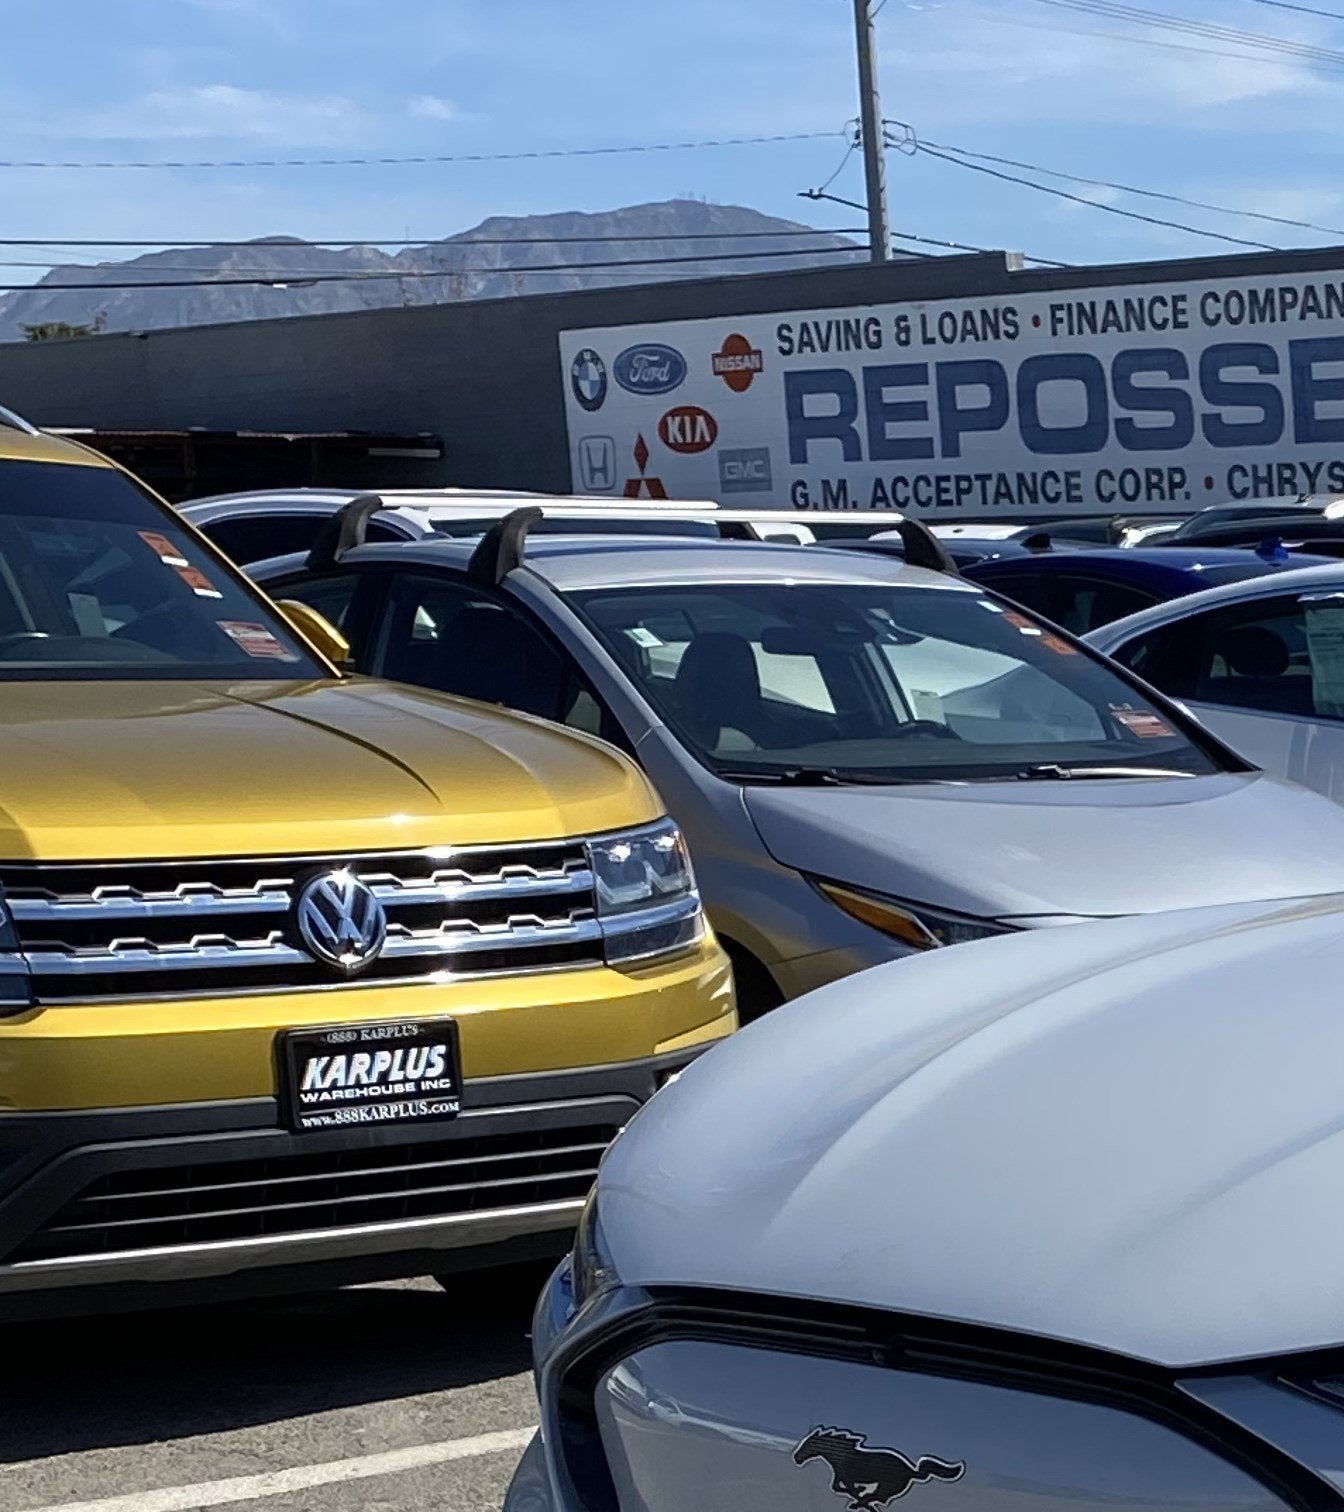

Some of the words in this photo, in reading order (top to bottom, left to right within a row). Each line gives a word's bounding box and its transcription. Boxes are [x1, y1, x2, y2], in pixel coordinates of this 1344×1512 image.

[776, 316, 883, 356] SAVING
[894, 314, 912, 347] &
[921, 306, 1021, 346] LOANS
[1049, 293, 1190, 337] FINANCE
[629, 353, 671, 383] Ford
[714, 353, 761, 374] NISSAN
[666, 414, 711, 444] KIA
[789, 478, 859, 511] G.M.
[870, 469, 1083, 509] ACCEPTANCE
[1095, 466, 1192, 502] CORP.
[301, 1045, 446, 1090] KARPLUS
[300, 1081, 416, 1103] WAREHOUSE
[421, 1078, 451, 1091] INC
